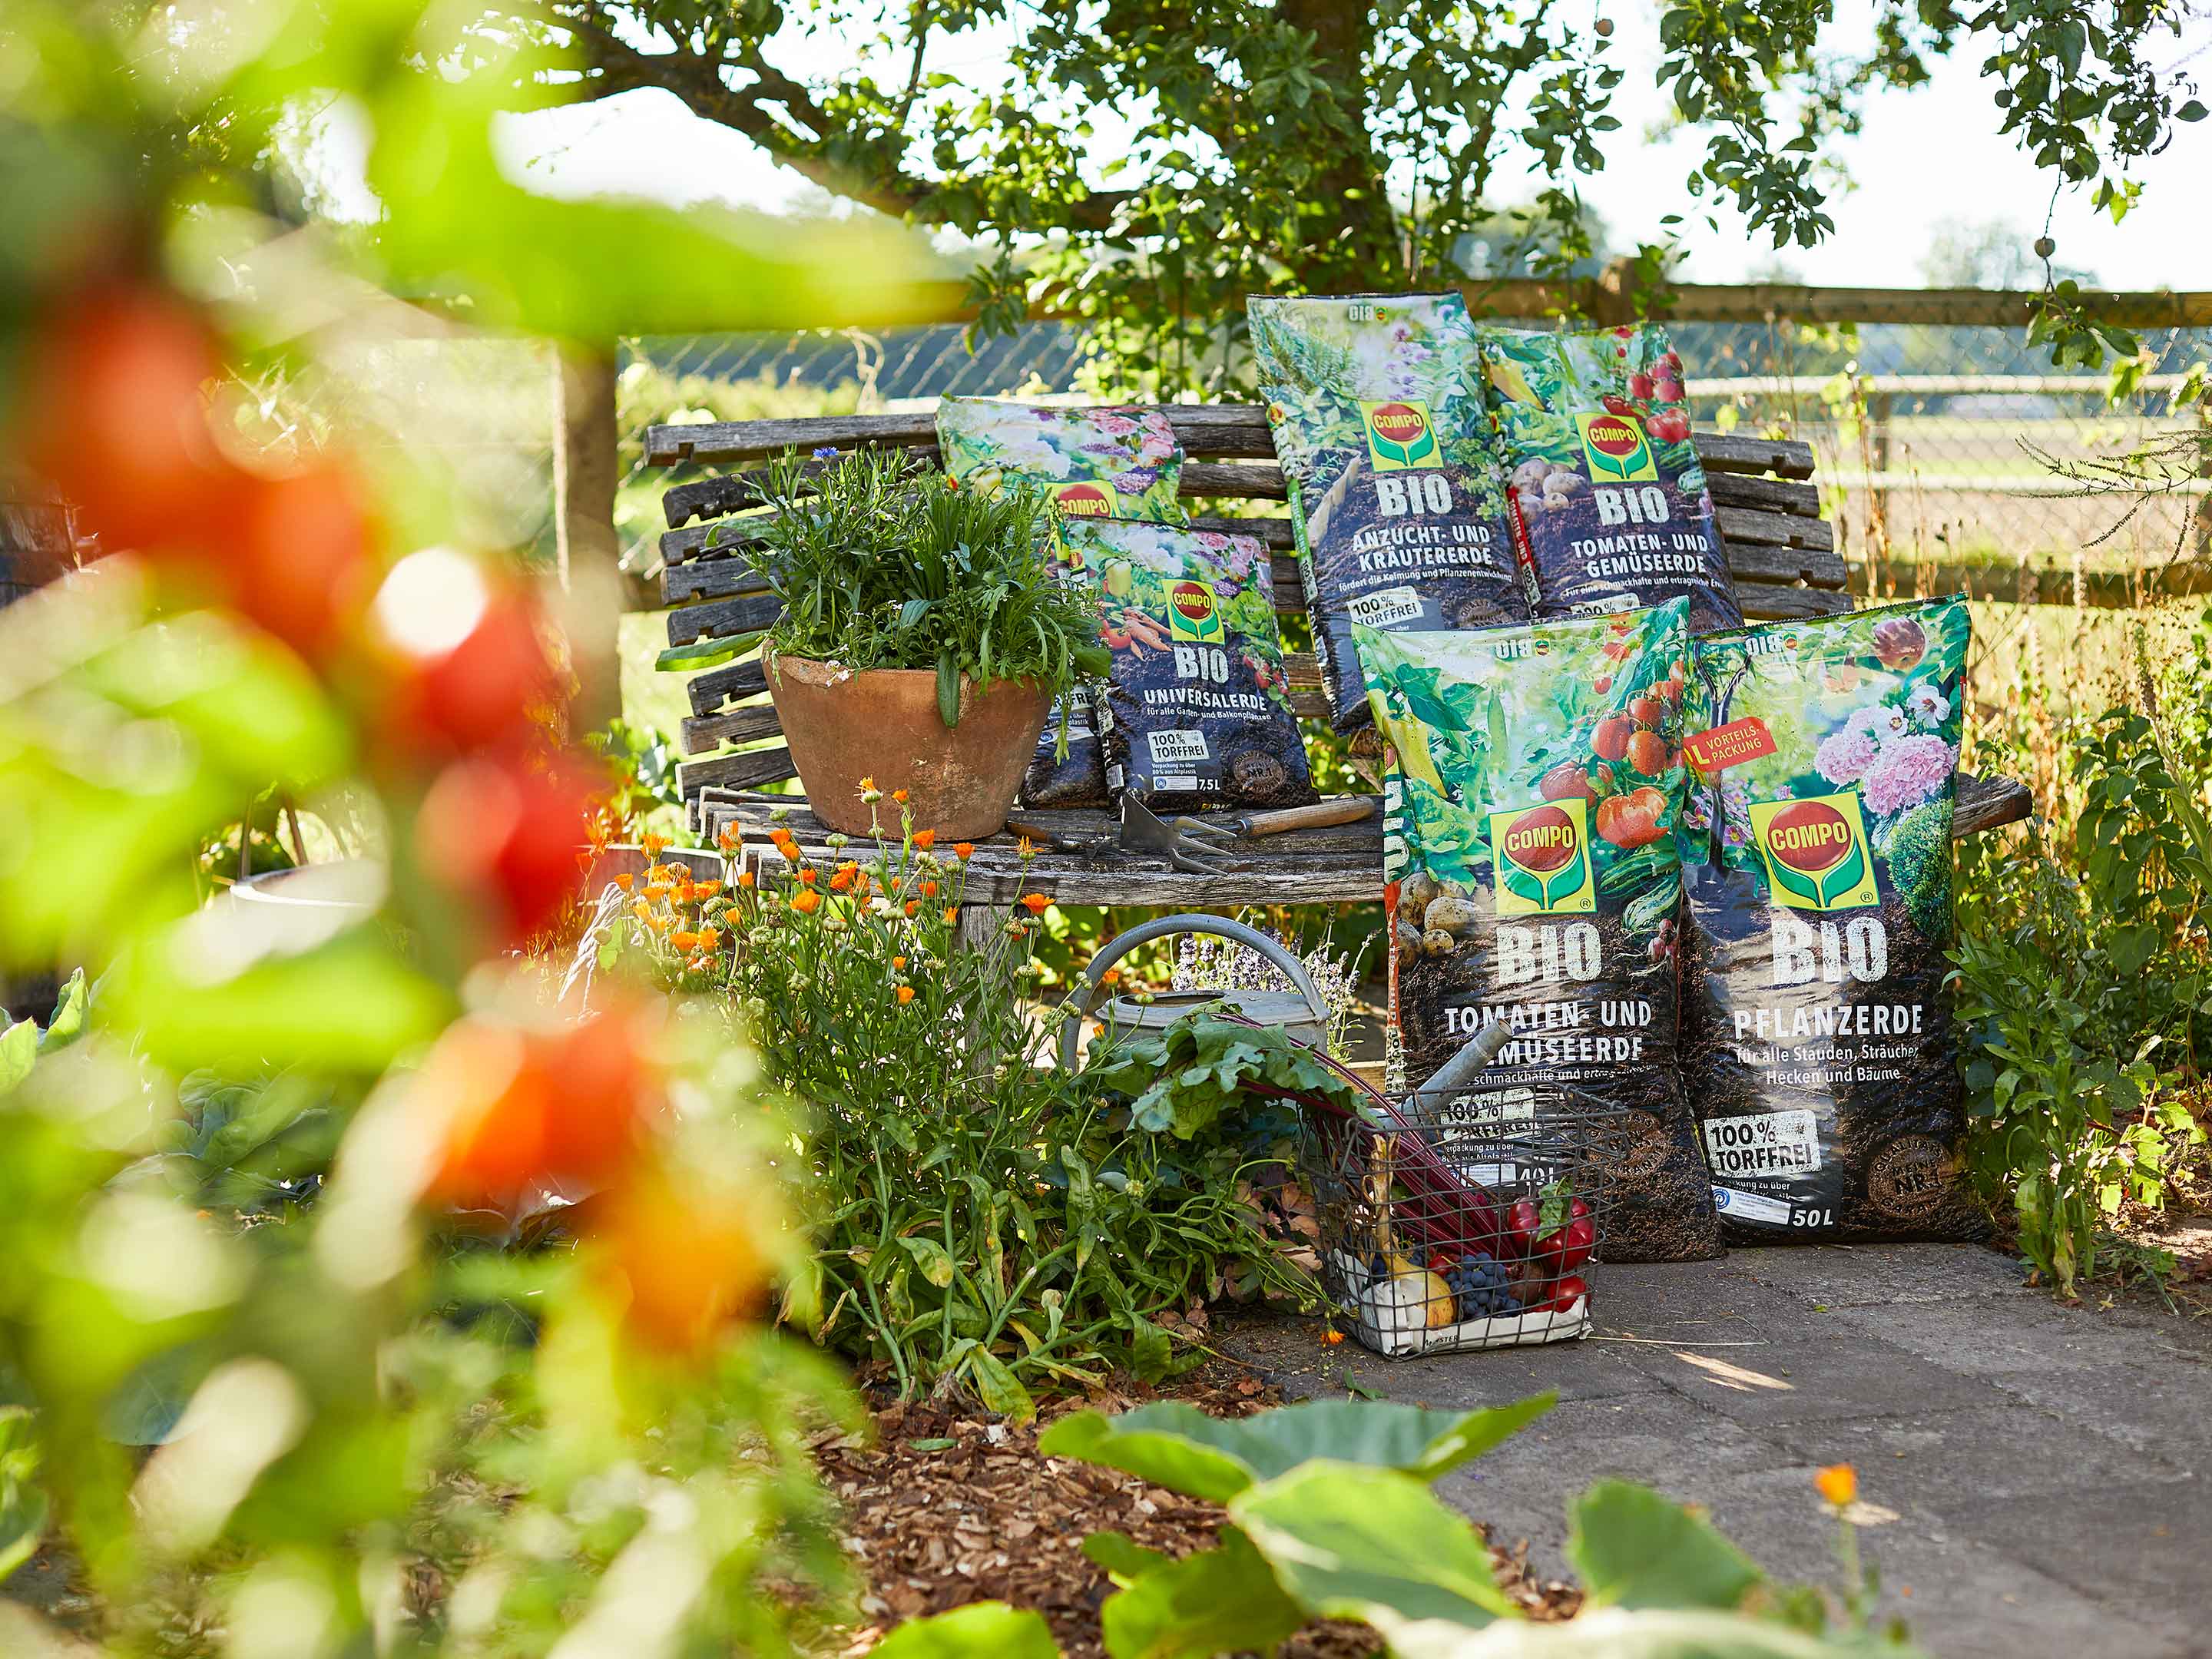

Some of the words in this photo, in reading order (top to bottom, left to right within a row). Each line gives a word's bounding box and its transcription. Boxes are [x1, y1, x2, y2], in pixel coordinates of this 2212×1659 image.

[1374, 414, 1423, 429] COMPO
[1589, 427, 1637, 442] COMPO
[1375, 474, 1453, 517] BIO
[1594, 486, 1670, 526] BIO
[1353, 525, 1447, 551] ANZUCHT-
[1452, 525, 1491, 543] UND
[1571, 534, 1667, 558] TOMATEN-
[1673, 534, 1708, 552] UND
[1359, 545, 1493, 572] KRÄUTERERDE
[1587, 551, 1707, 578] GEMÜSEERDE
[1339, 575, 1367, 592] fördert
[1369, 574, 1382, 584] die
[1383, 569, 1421, 583] Keimung
[1422, 568, 1439, 578] und
[1654, 576, 1669, 584] und
[1174, 592, 1211, 608] COMPO
[1495, 639, 1532, 659] BIO
[1746, 632, 1783, 655] BIO
[1173, 647, 1230, 684] BIO
[1144, 688, 1268, 711] UNIVERSALERDE
[1147, 707, 1158, 716] für
[1160, 707, 1175, 715] alle
[1176, 707, 1200, 717] Garten-
[1201, 710, 1216, 719] und
[1217, 710, 1272, 720] Balkonpflanzen
[1705, 724, 1760, 750] VORTEILS-
[1711, 737, 1763, 762] PACKUNG
[1154, 745, 1205, 758] TORFFREI
[1507, 825, 1575, 852] COMPO
[1770, 821, 1849, 852] COMPO
[1495, 922, 1602, 985] BIO
[1772, 916, 1889, 985] BIO
[1445, 1001, 1591, 1034] TOMATEN-
[1601, 1001, 1652, 1027] UND
[1734, 1005, 1922, 1040] PFLANZERDE
[1487, 1033, 1642, 1065] MÜSEERDE
[1737, 1048, 1759, 1064] für
[1762, 1046, 1790, 1062] alle
[1793, 1046, 1859, 1062] Stauden,
[1861, 1044, 1919, 1060] Sträucher,
[1474, 1069, 1555, 1086] schmackhafte
[1558, 1068, 1581, 1081] und
[1767, 1069, 1820, 1084] Hecken
[1826, 1067, 1853, 1083] und
[1857, 1067, 1901, 1081] Bäume
[1716, 1143, 1813, 1171] TORFFREI
[1770, 1181, 1791, 1190] über
